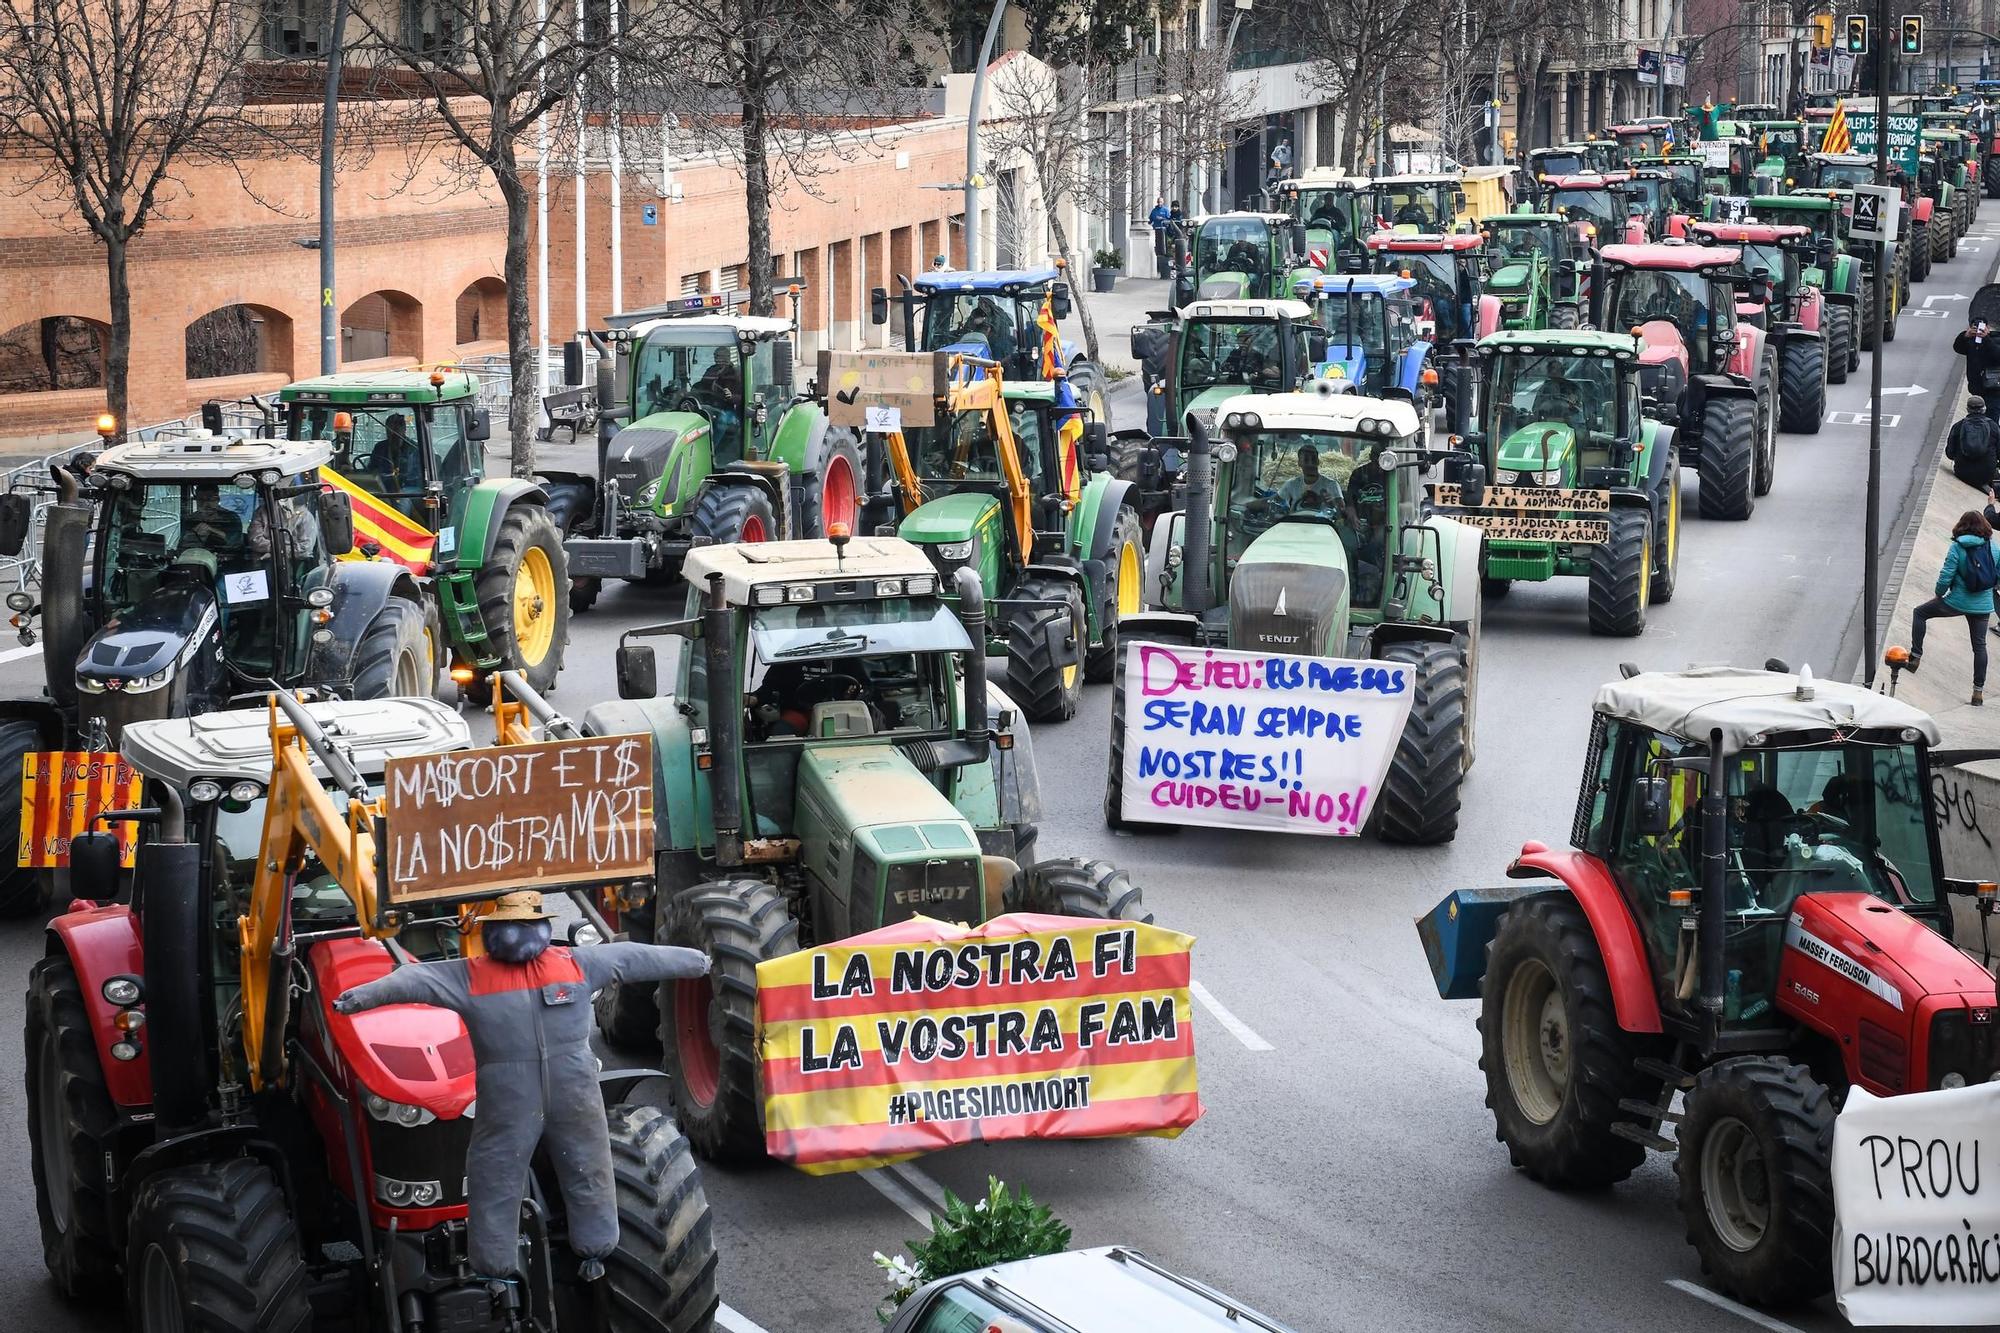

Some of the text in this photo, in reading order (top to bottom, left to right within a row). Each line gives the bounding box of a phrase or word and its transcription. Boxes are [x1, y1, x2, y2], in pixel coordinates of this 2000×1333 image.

[1845, 117, 1867, 129] OLEM
[1488, 498, 1498, 506] A
[1504, 497, 1518, 507] LA
[1492, 487, 1505, 496] EL
[1511, 488, 1561, 498] TRACTOR
[1259, 634, 1300, 643] FENDT
[1143, 700, 1362, 742] SERAN SEMPRE
[26, 757, 143, 785] LA NOSTRA
[1139, 746, 1303, 791] NOSTRES!!
[1151, 780, 1368, 835] CUIDEU-NOS!
[19, 832, 33, 859] LA
[394, 832, 428, 883] LA
[570, 787, 651, 870] MORT
[812, 930, 1136, 999] LA NOSTRA FI
[1799, 936, 1871, 985] MASSEY FERGUSON
[1794, 982, 1819, 1004] 5455
[801, 997, 1177, 1072] LA VOSTRA FAM
[889, 1076, 1091, 1125] #PAGESIAOMORT
[1859, 1135, 1979, 1200] PROU
